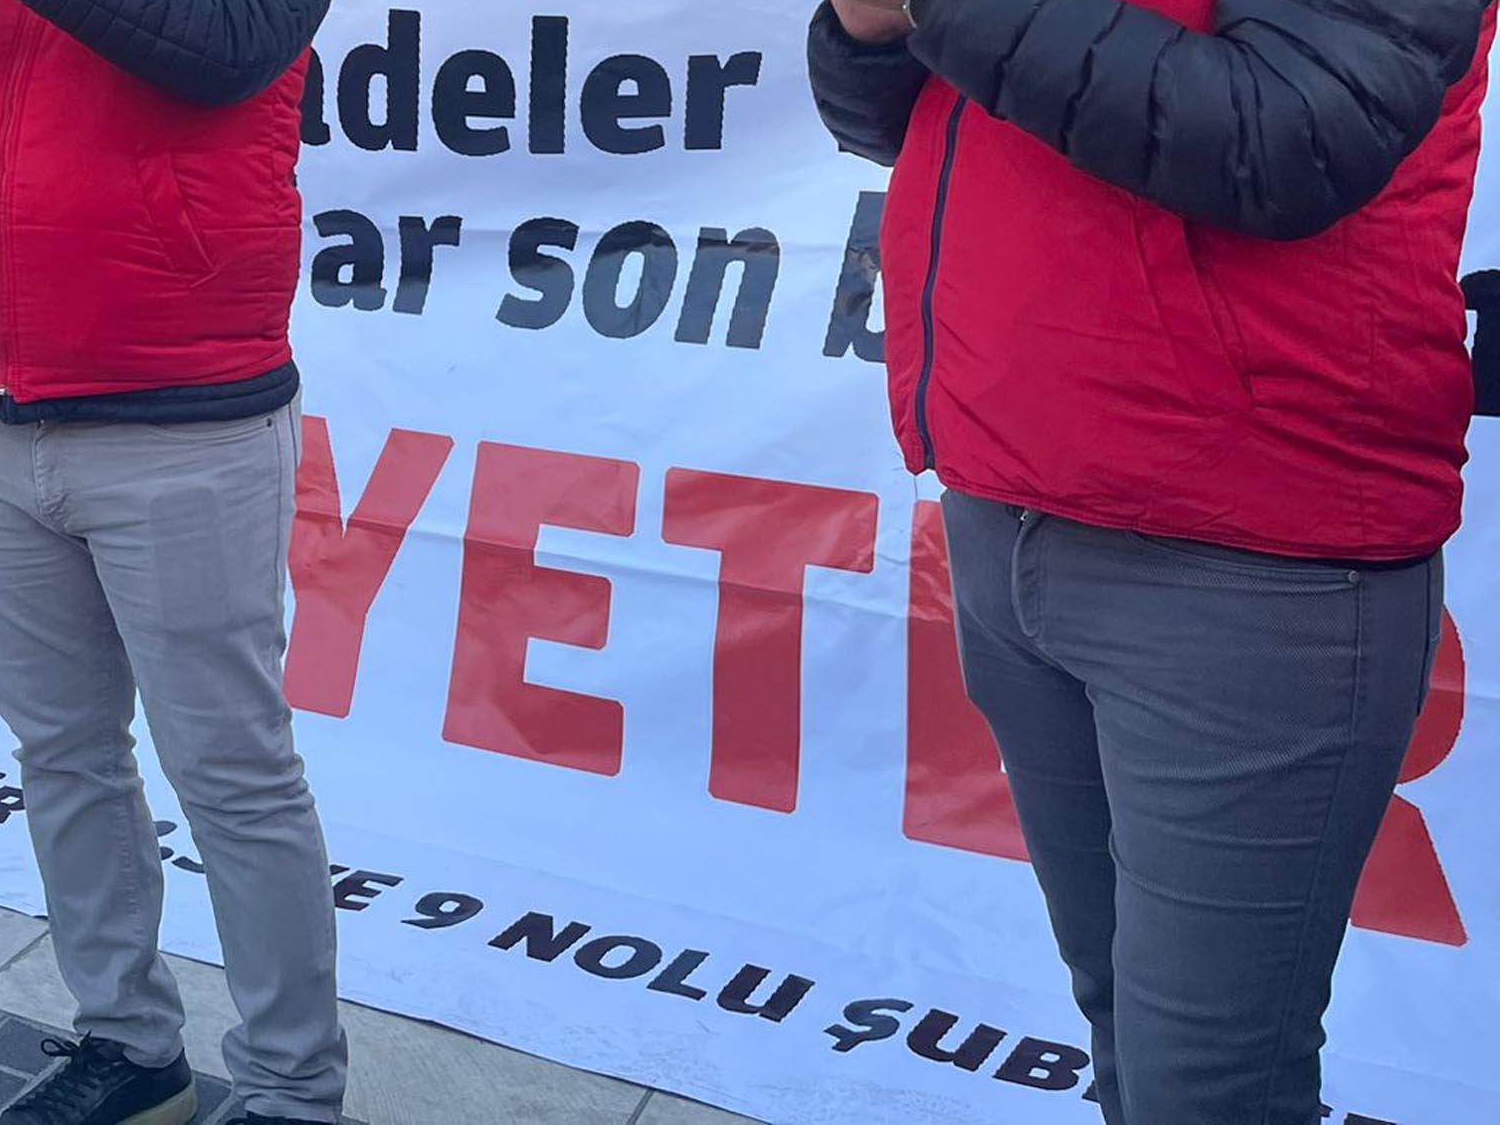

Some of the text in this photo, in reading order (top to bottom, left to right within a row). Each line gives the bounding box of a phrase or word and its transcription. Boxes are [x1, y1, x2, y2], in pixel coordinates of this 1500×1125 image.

[495, 216, 781, 351] son
[400, 892, 485, 929] 9
[488, 911, 815, 1022] NOLU
[824, 998, 1100, 1101] ŞUB
